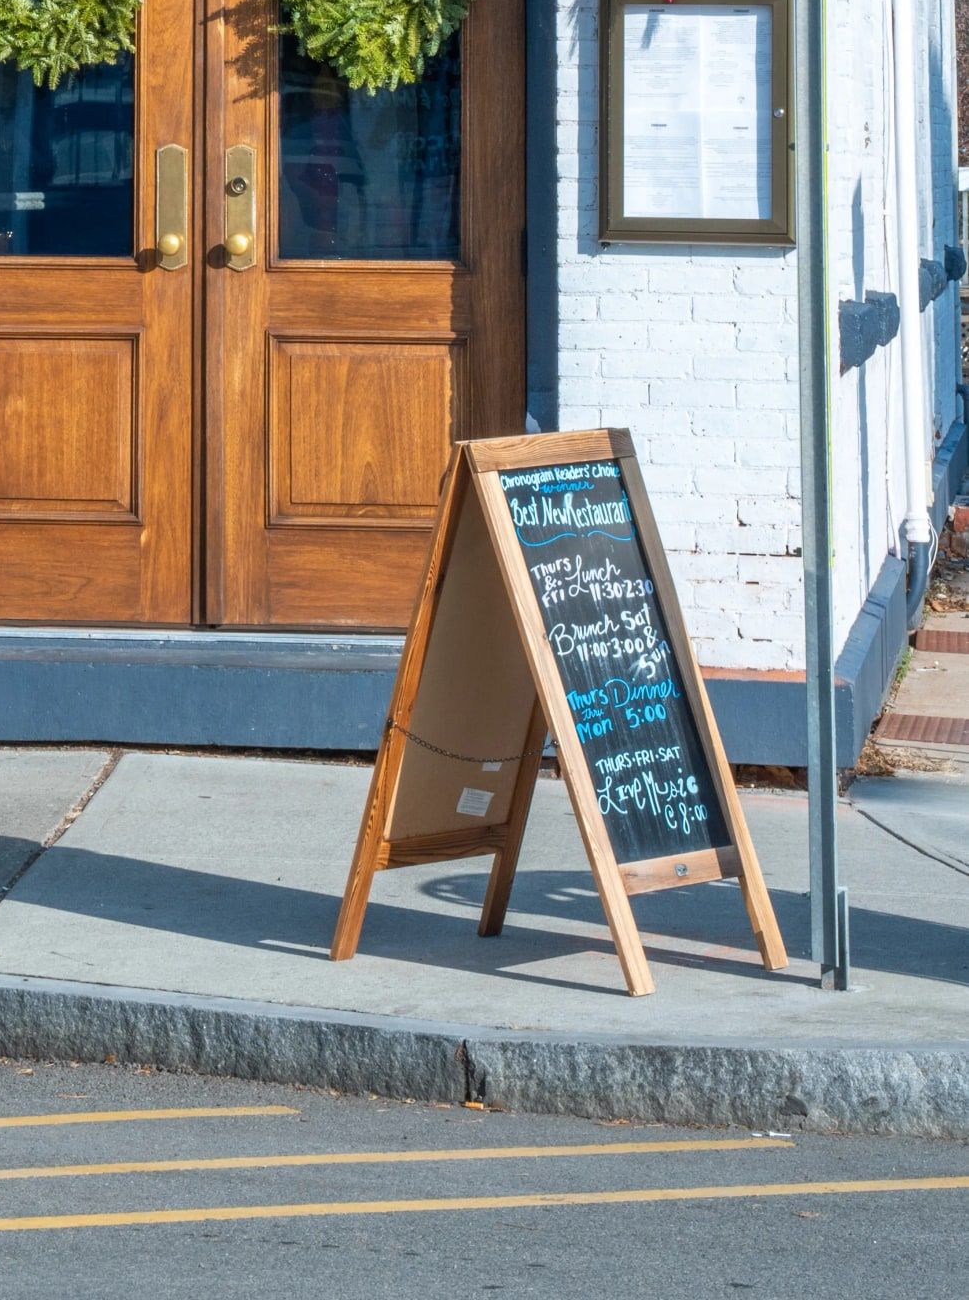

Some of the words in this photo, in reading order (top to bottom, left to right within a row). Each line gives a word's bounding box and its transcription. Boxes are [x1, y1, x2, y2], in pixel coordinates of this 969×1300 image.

[500, 469, 554, 491] Chronogram
[510, 496, 539, 526] Best
[541, 496, 567, 527] New
[564, 491, 631, 528] Restaurant
[530, 557, 571, 580] Thurs
[565, 554, 621, 597] Lunch
[548, 614, 620, 656] Brunch
[620, 602, 651, 630] Sat
[638, 640, 670, 679] Sun
[566, 688, 609, 710] Thurs
[604, 677, 680, 708] Dinner
[576, 718, 613, 744] Mon
[625, 703, 667, 729] 5:00
